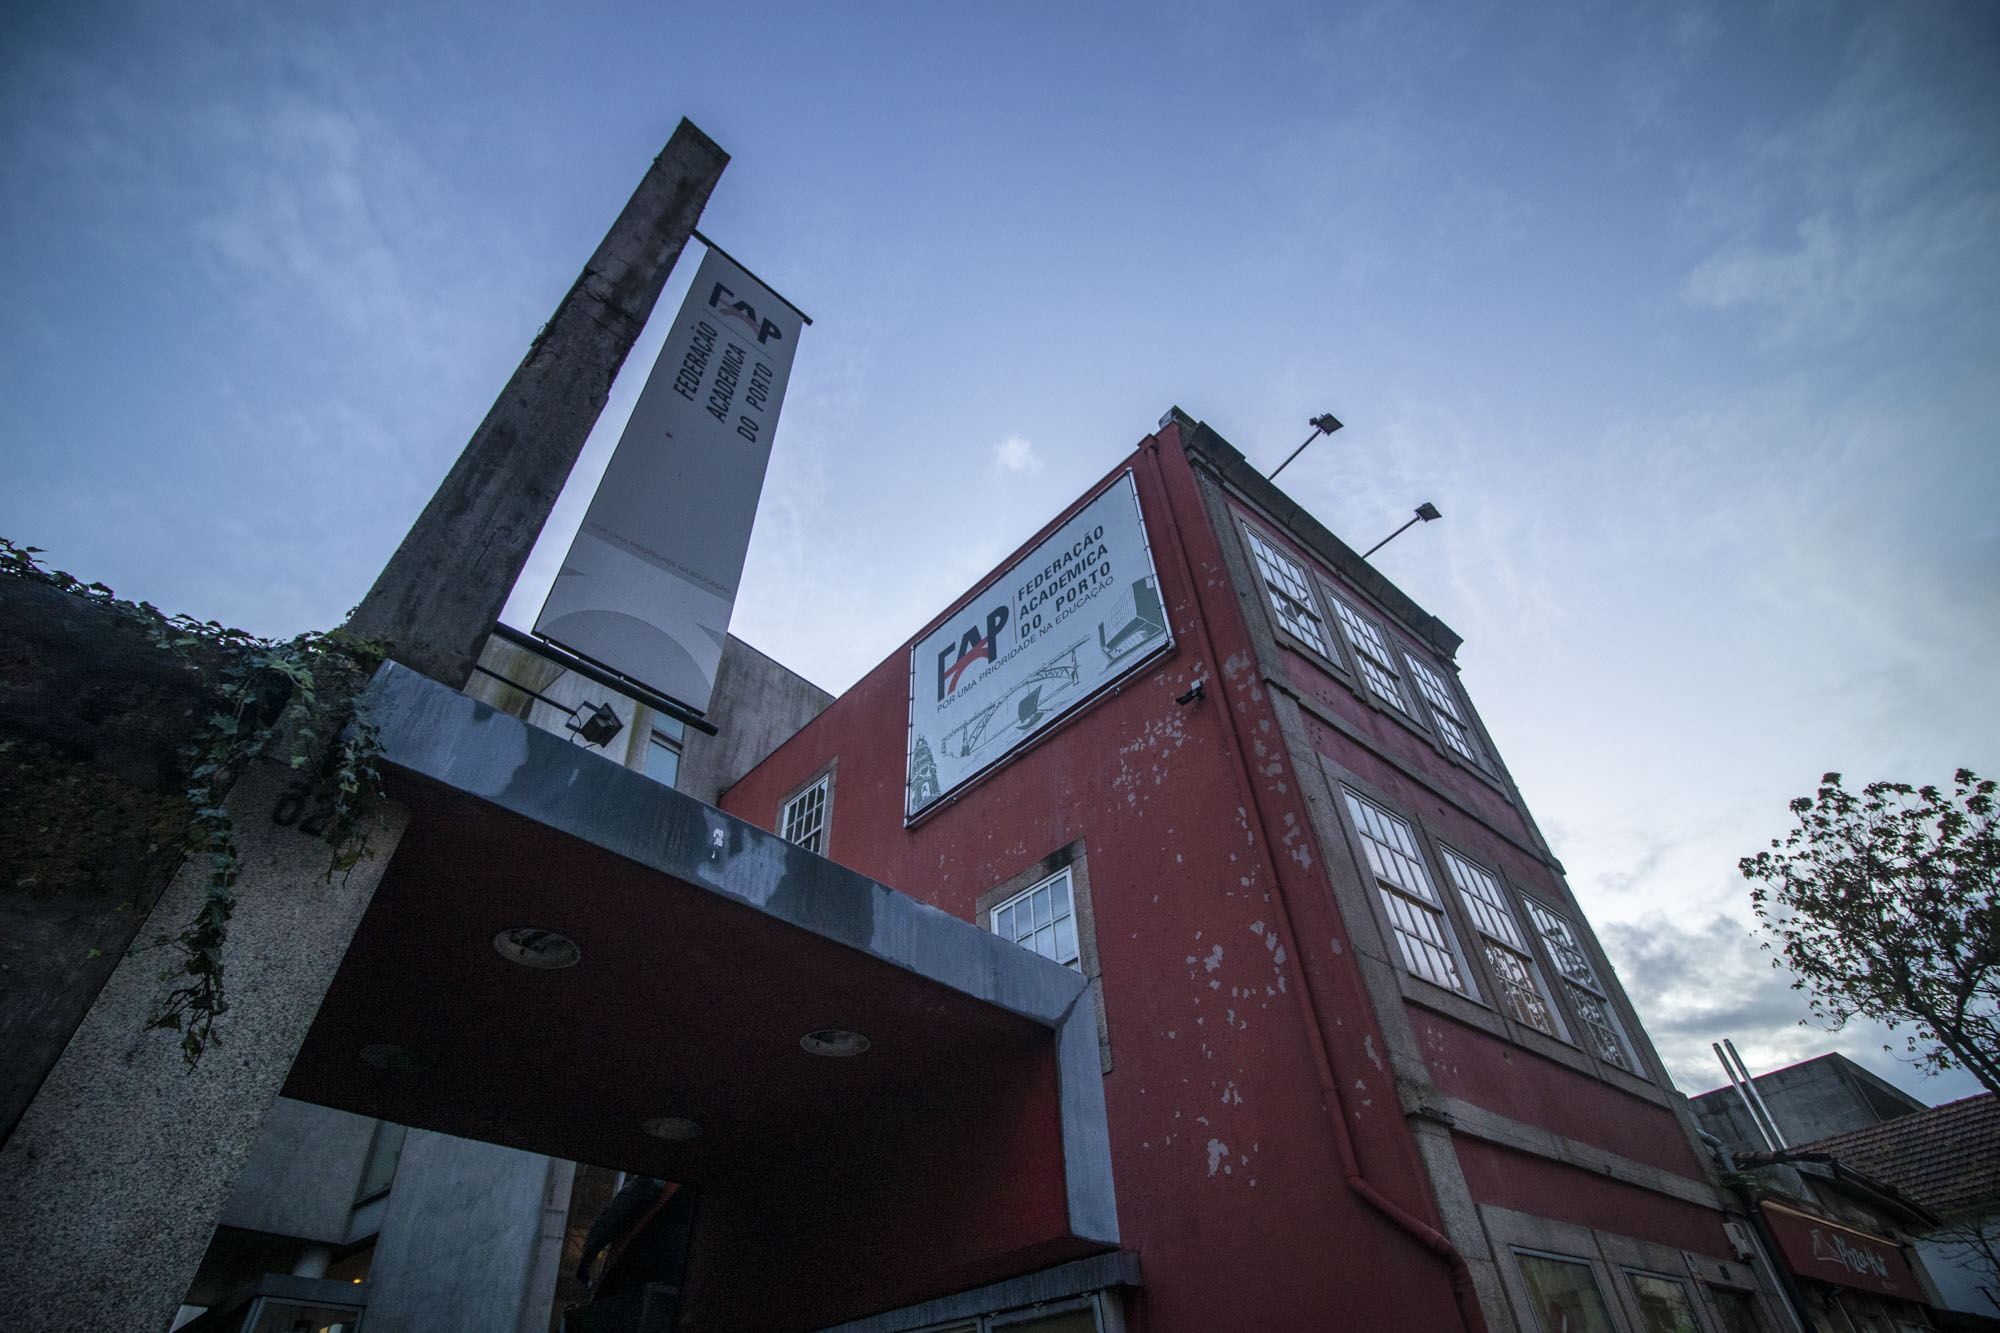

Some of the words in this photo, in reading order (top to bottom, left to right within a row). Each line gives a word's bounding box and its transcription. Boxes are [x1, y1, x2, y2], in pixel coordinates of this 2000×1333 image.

[708, 281, 782, 345] FAP
[673, 321, 718, 402] FEDERAÇÃO
[706, 342, 746, 424] ACADEMICA
[745, 362, 773, 412] PORTO
[736, 415, 759, 443] DO
[1018, 525, 1103, 602] FEDERAÇÃO
[1020, 543, 1108, 620] ACADEMICA
[1021, 613, 1042, 639] DO
[1055, 561, 1111, 612] PORTO
[937, 696, 955, 714] POR
[957, 679, 977, 698] UMA
[979, 635, 1037, 683] PRIORIDADE
[1039, 622, 1053, 637] NA
[1055, 575, 1114, 624] EDUCAÇÃO
[937, 605, 1009, 703] FAP
